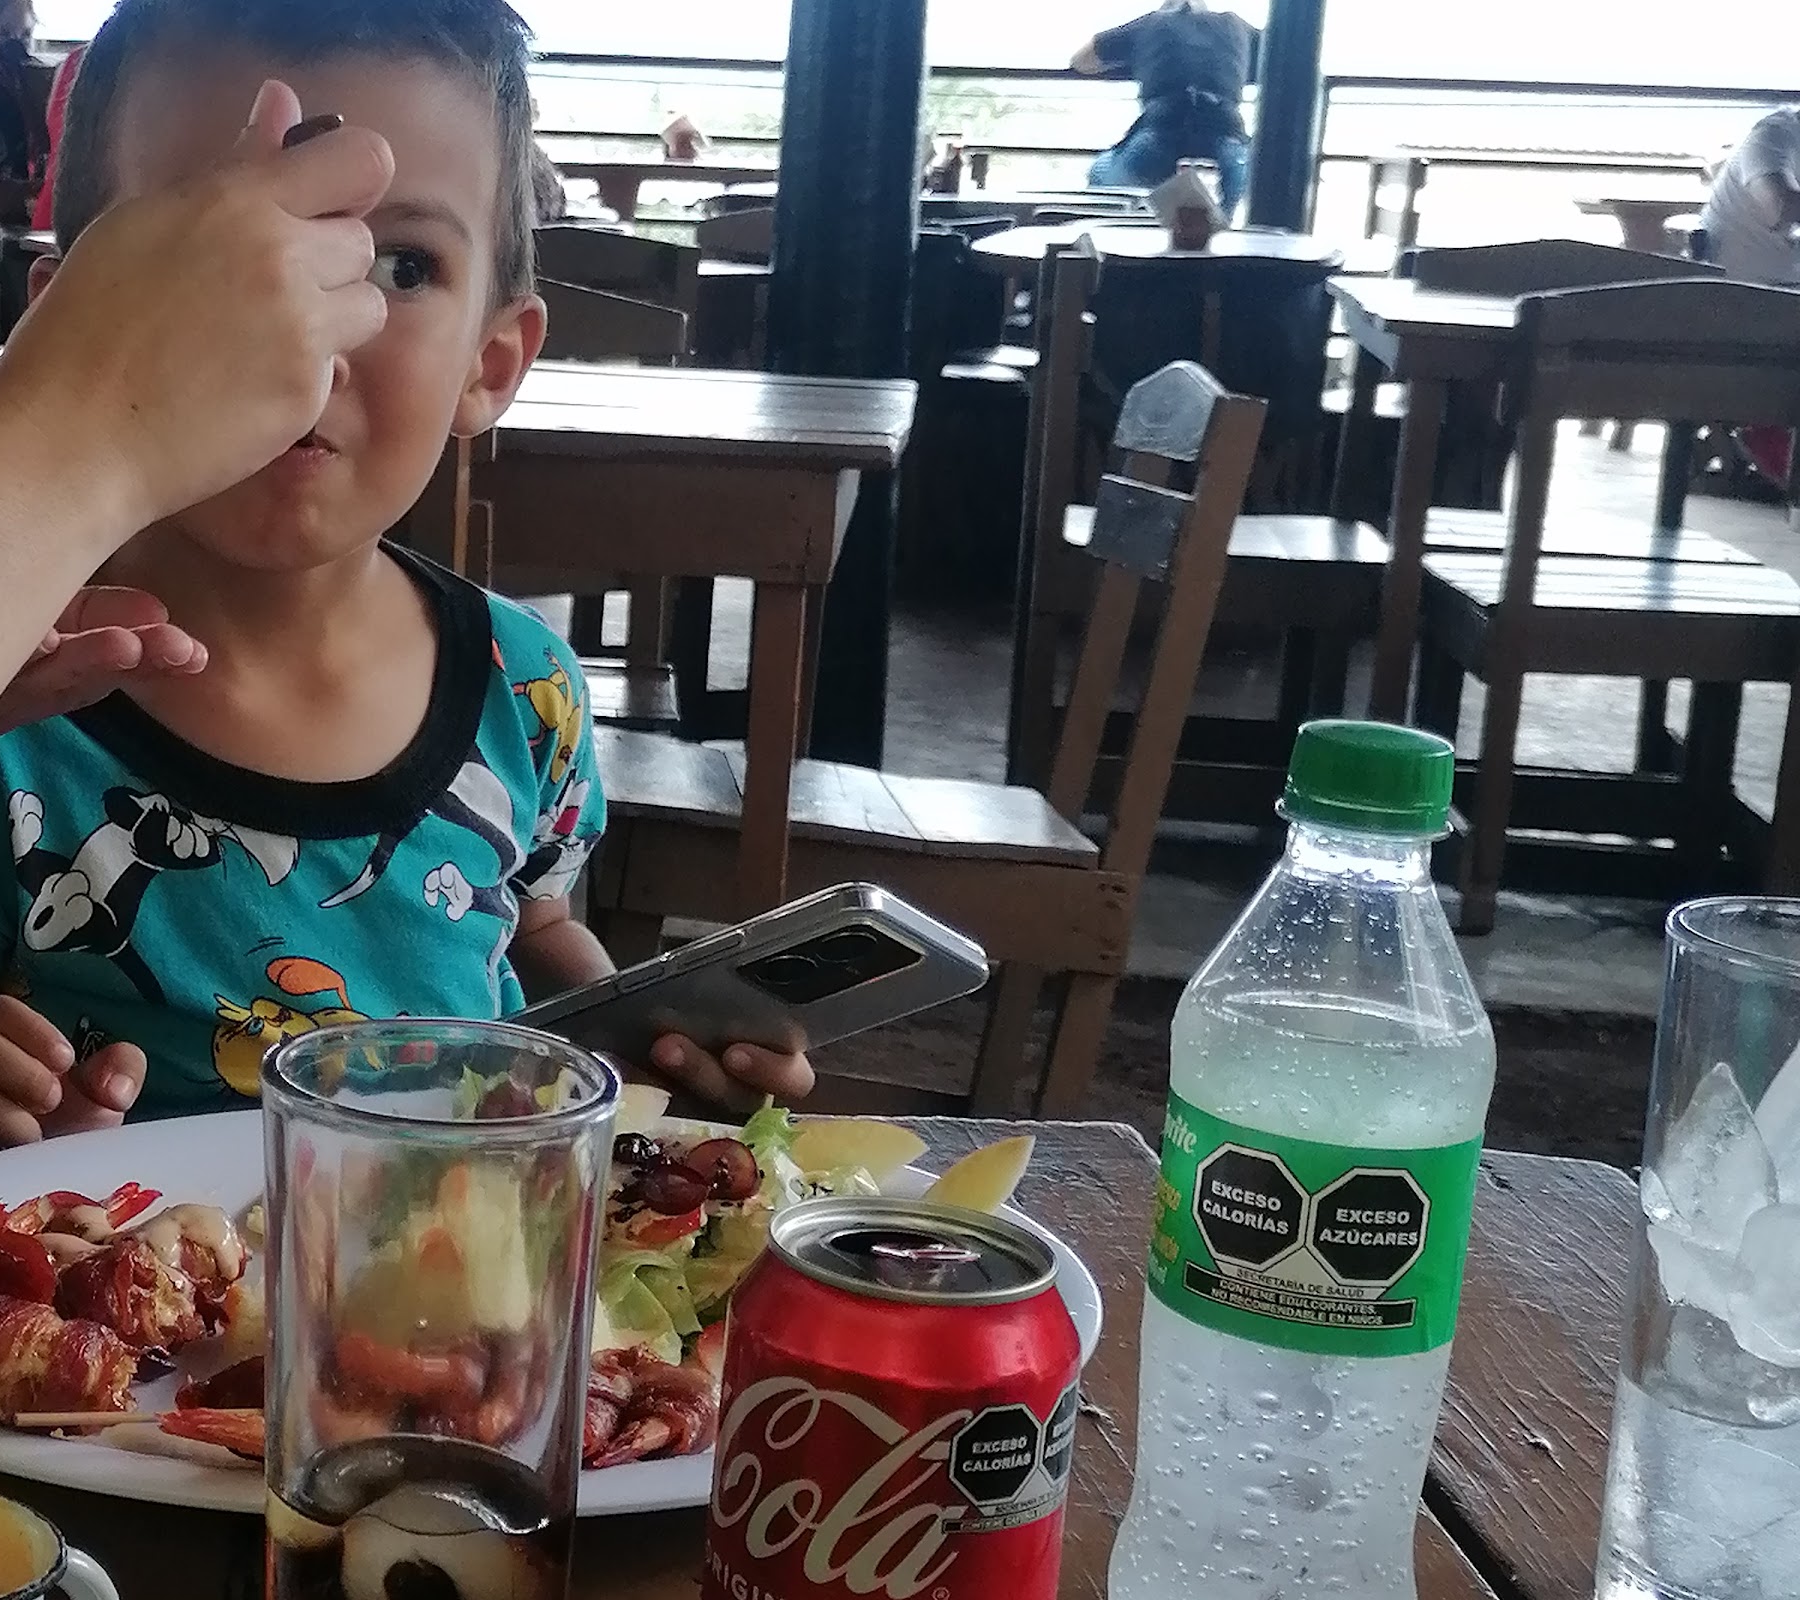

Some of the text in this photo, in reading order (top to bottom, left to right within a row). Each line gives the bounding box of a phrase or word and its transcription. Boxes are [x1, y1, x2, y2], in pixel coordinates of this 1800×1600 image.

[1211, 1179, 1282, 1212] EXCESO
[1202, 1199, 1290, 1235] CALORÍAS
[1335, 1207, 1411, 1226] EXCESO
[1319, 1227, 1419, 1247] AZÚCARES
[1218, 1279, 1276, 1303] CONTIENE
[1307, 1284, 1324, 1296] DE
[1325, 1286, 1365, 1299] SALUD
[971, 1435, 1029, 1455] EXCESO
[962, 1451, 1033, 1473] CALORÍAS
[711, 1376, 974, 1600] Cola
